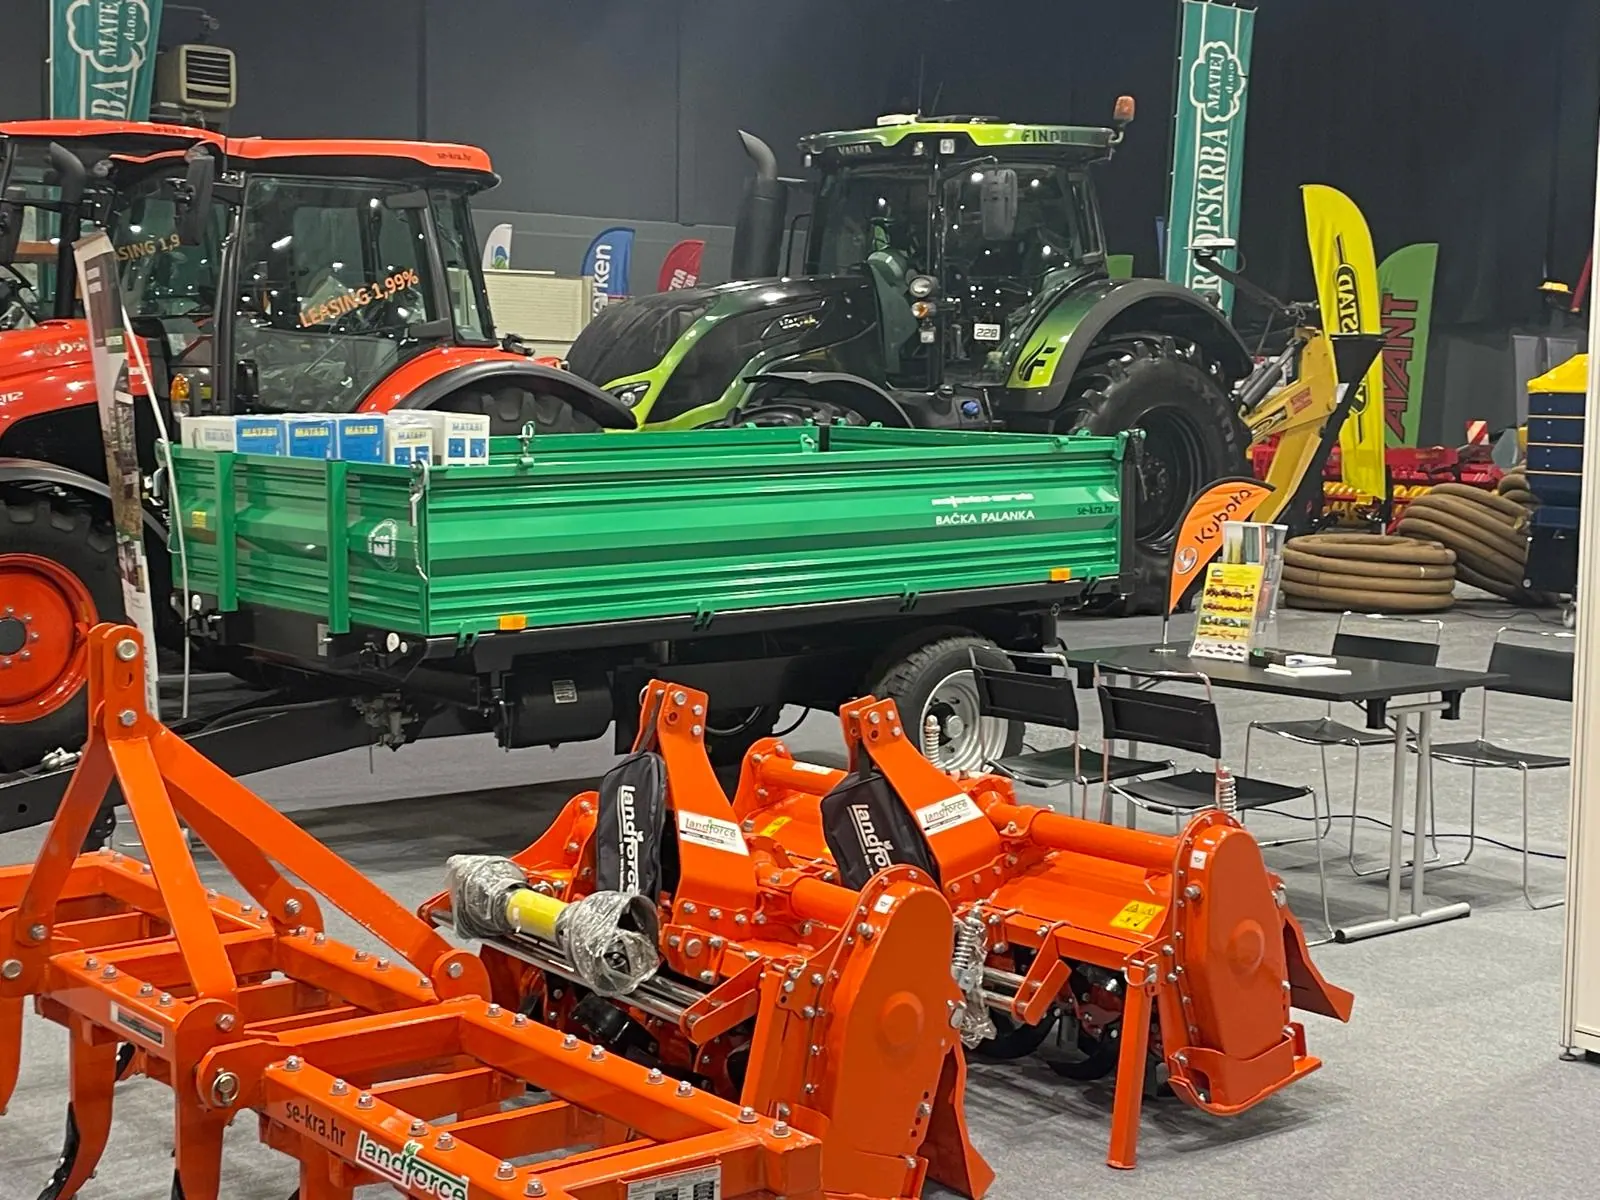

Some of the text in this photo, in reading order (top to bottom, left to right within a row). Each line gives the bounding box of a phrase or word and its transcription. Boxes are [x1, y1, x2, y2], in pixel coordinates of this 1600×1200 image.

[98, 0, 120, 57] MATE
[1207, 52, 1225, 110] MATEJ
[299, 268, 420, 328] LEASING 1,99%
[976, 328, 998, 339] 228
[1382, 293, 1419, 443] AVANT
[935, 510, 1035, 525] BAČKA PALANKA
[1194, 489, 1252, 544] Kubota
[685, 818, 738, 838] landforce
[286, 1101, 346, 1148] se-kra.hr
[358, 1132, 467, 1200] landforce
